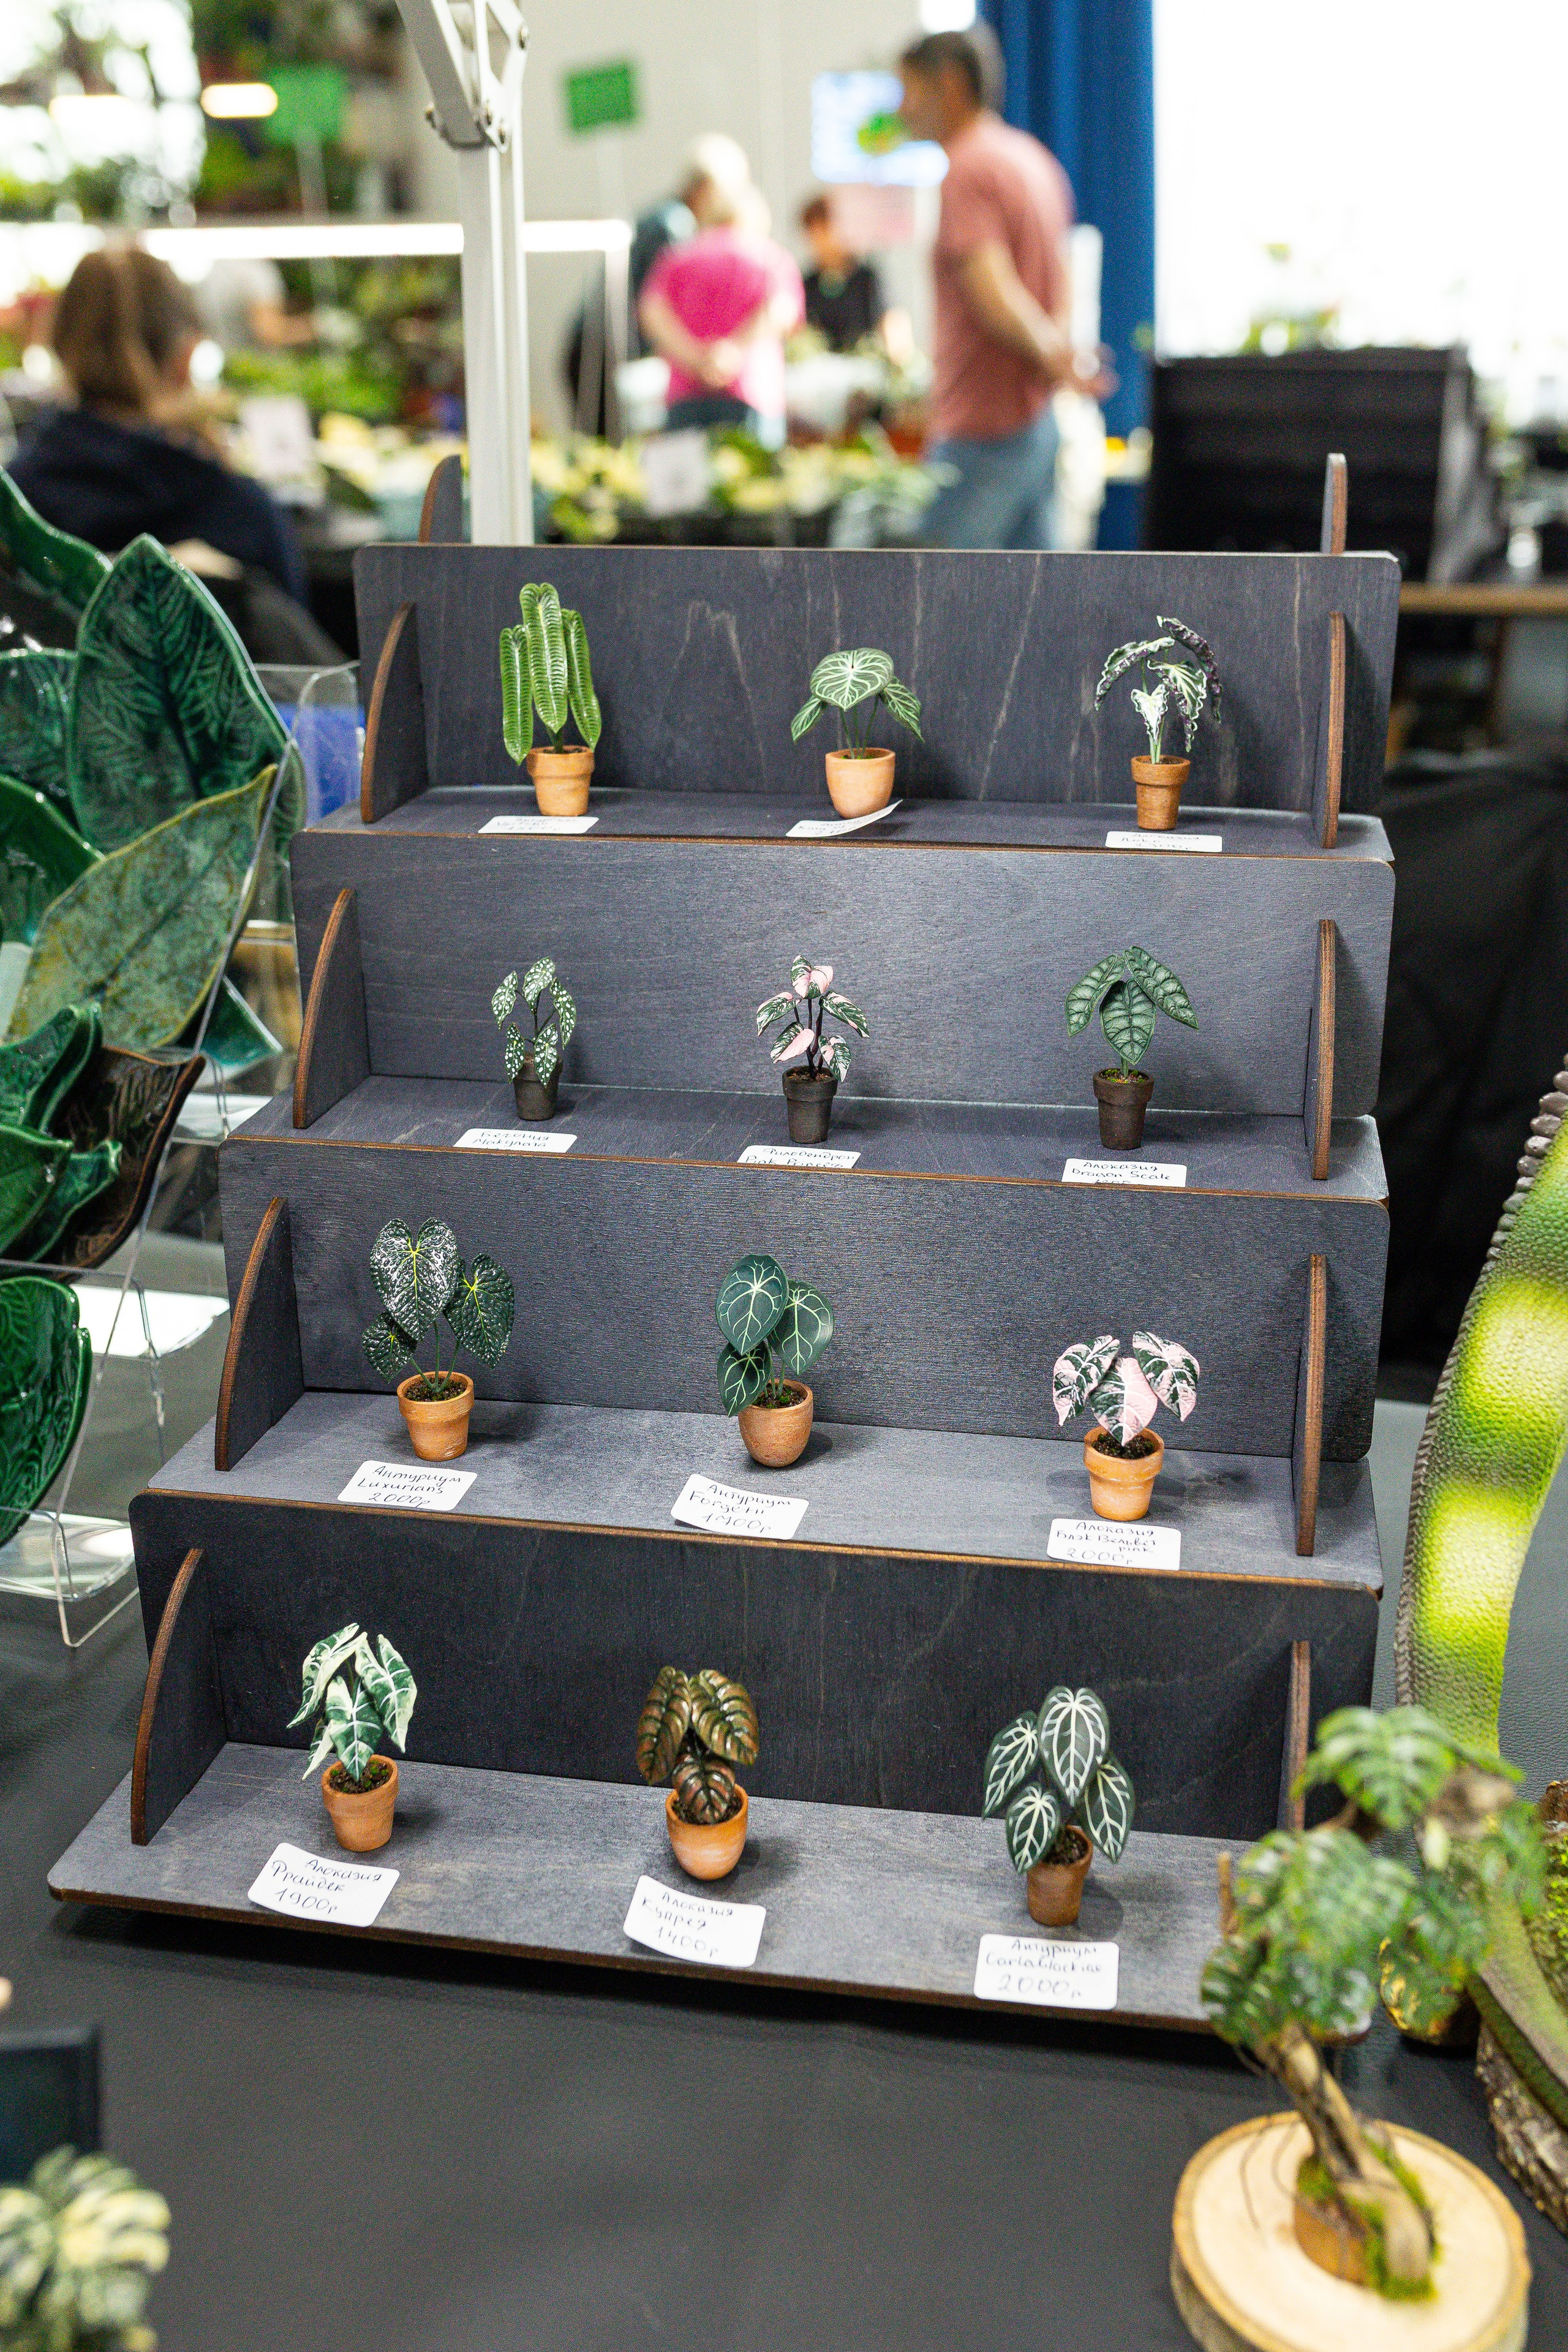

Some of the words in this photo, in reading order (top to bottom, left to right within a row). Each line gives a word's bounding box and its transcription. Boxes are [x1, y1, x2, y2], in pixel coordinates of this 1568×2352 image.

[745, 1155, 777, 1164] Pink
[1084, 1162, 1158, 1172] Алоказия
[1072, 1168, 1122, 1177] Dragon
[1131, 1170, 1170, 1180] Scale
[372, 1466, 461, 1487] Антуриум
[357, 1477, 443, 1494] Luxurians
[369, 1492, 431, 1507] 2000р
[690, 1490, 764, 1514] Forgetii
[707, 1484, 791, 1507] Антуриум
[1076, 1521, 1154, 1537] Алоказия
[1057, 1530, 1093, 1541] Блэк
[1098, 1535, 1157, 1546] Вельвет
[271, 1860, 346, 1892] Фрайдек
[306, 1859, 383, 1882] Алоказия
[662, 1891, 733, 1916] Алоказия
